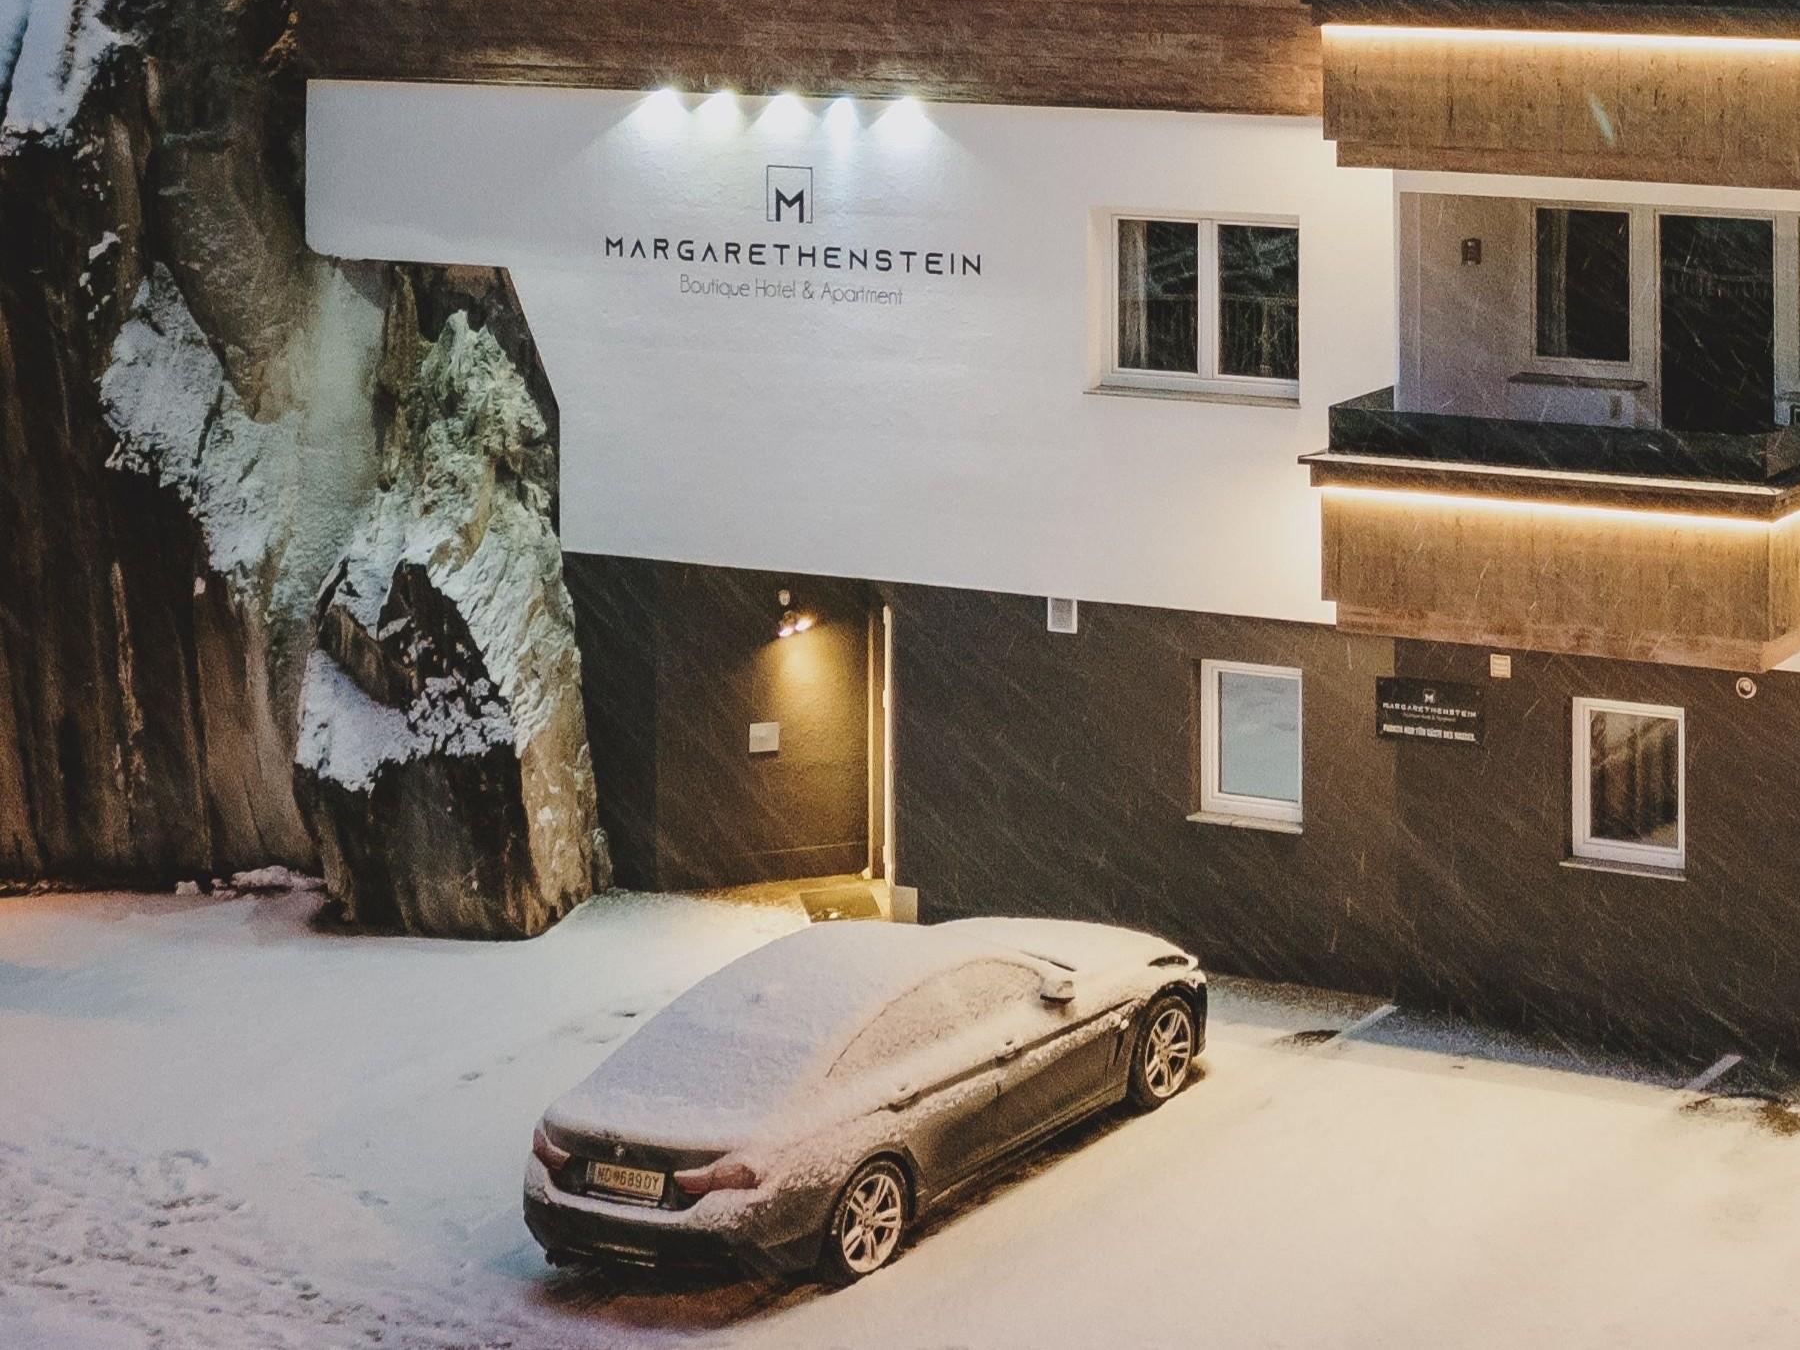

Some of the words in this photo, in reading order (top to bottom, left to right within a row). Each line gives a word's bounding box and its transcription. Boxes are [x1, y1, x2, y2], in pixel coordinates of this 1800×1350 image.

[775, 187, 805, 223] M
[605, 236, 982, 275] MARGARETHENSTEIN
[680, 273, 750, 299] Boutique
[755, 278, 796, 299] Hotel
[802, 281, 814, 300] &
[821, 282, 903, 306] Apartment
